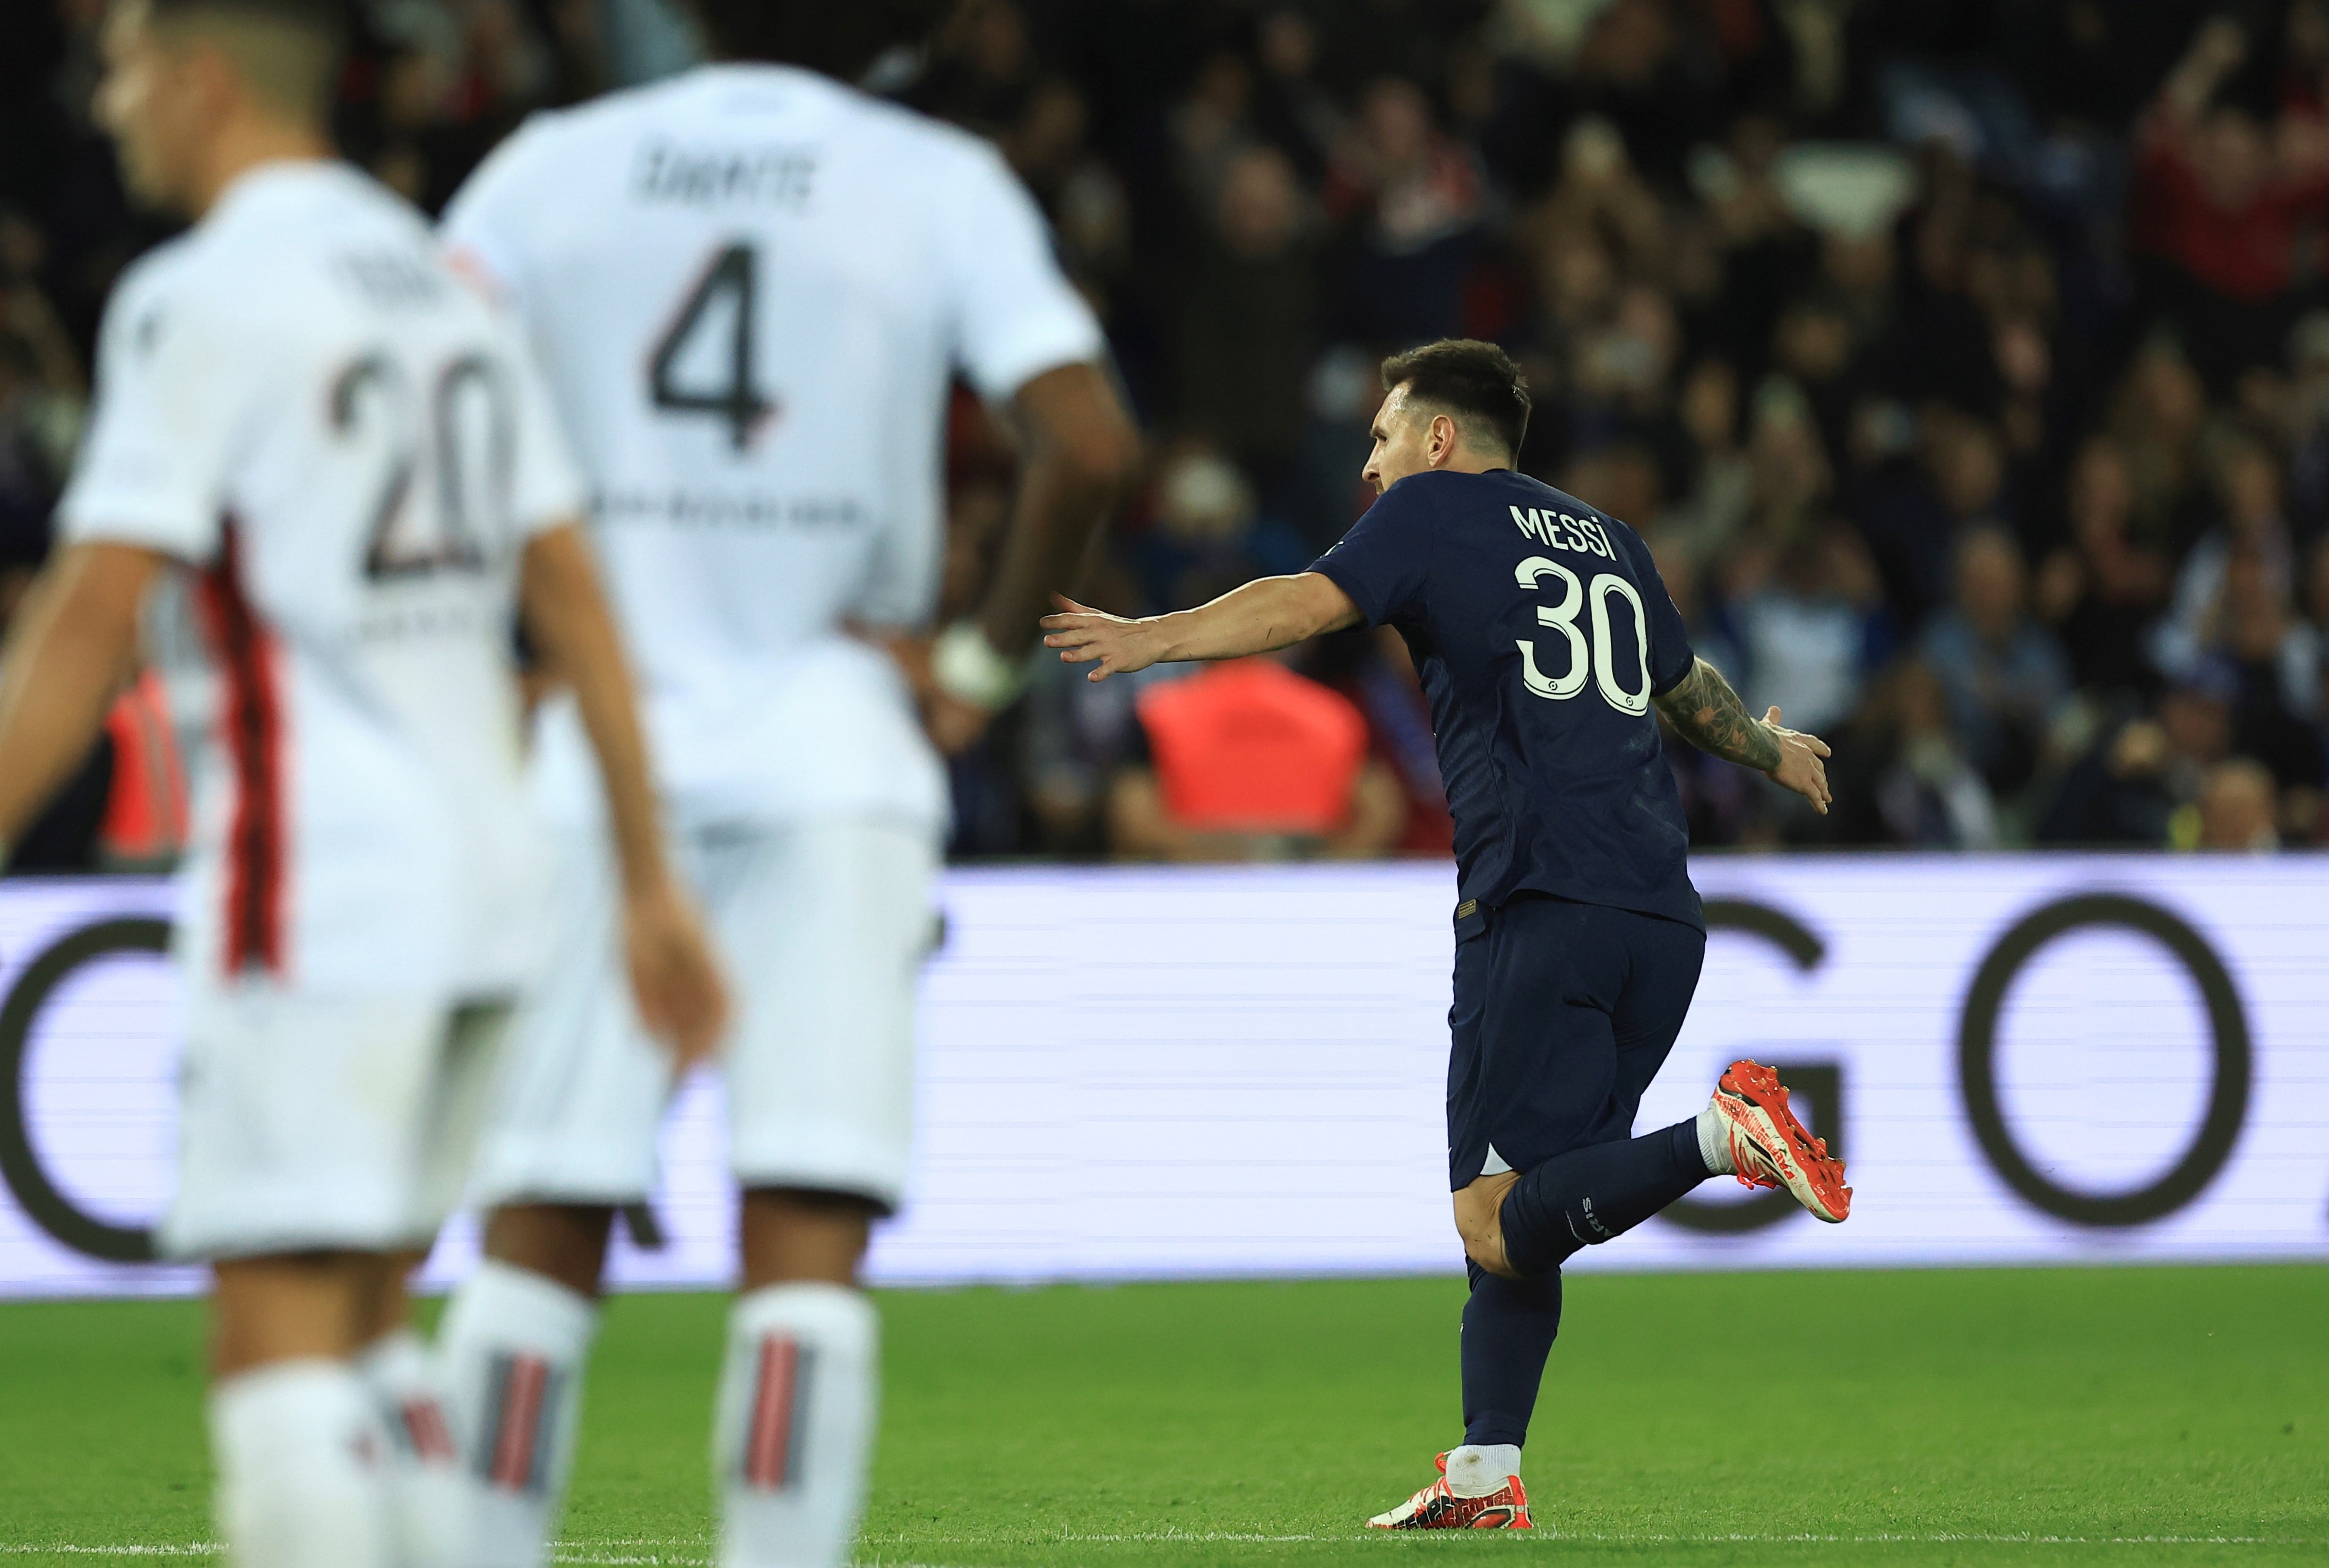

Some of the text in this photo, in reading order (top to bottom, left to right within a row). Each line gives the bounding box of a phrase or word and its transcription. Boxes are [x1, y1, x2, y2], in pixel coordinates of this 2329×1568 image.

[646, 239, 780, 455] 4
[325, 350, 516, 582] 20
[1514, 556, 1651, 717] 30
